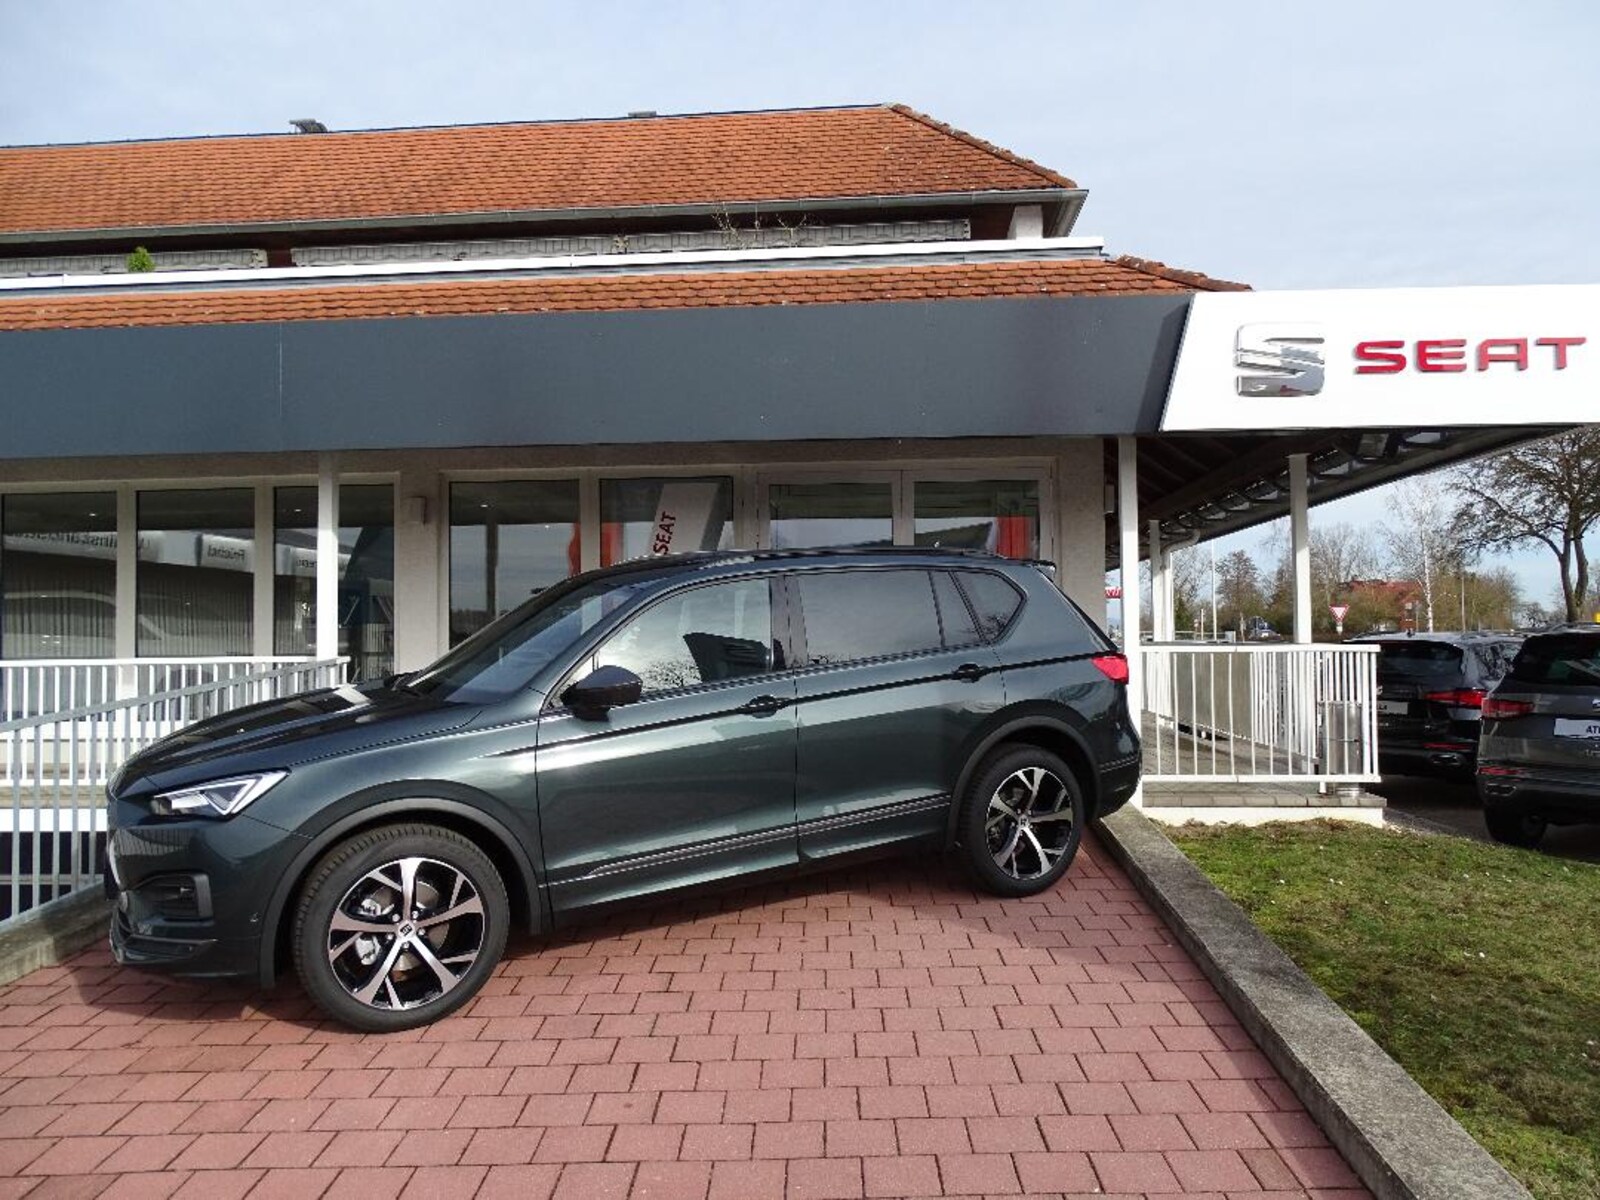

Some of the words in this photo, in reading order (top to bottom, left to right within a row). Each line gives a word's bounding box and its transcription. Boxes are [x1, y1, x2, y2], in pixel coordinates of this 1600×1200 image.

[1354, 336, 1587, 375] SEAT
[652, 511, 677, 556] SEAT
[1586, 725, 1600, 735] AT
